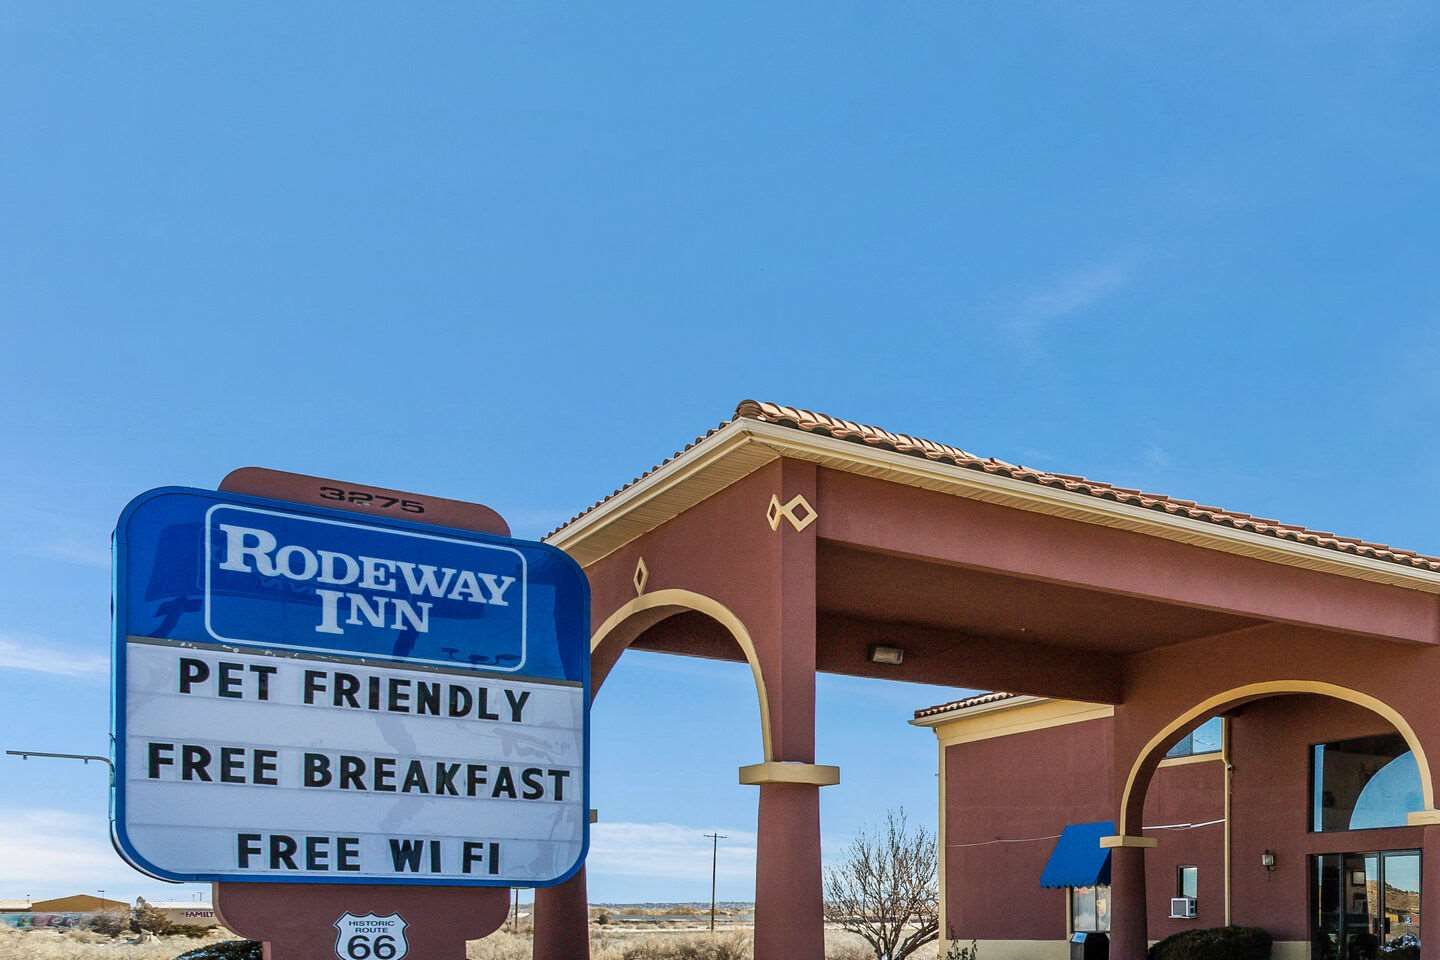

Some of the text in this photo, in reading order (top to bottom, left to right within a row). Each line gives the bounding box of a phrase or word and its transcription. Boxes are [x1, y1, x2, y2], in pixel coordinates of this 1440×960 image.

[320, 486, 425, 514] 3275
[219, 523, 516, 606] RODEWAY
[315, 588, 432, 634] INN
[179, 657, 531, 723] PET FRIENDLY
[148, 742, 570, 801] FREE BREAKFAST
[237, 833, 500, 875] FREE WI FI
[347, 935, 396, 960] 66
